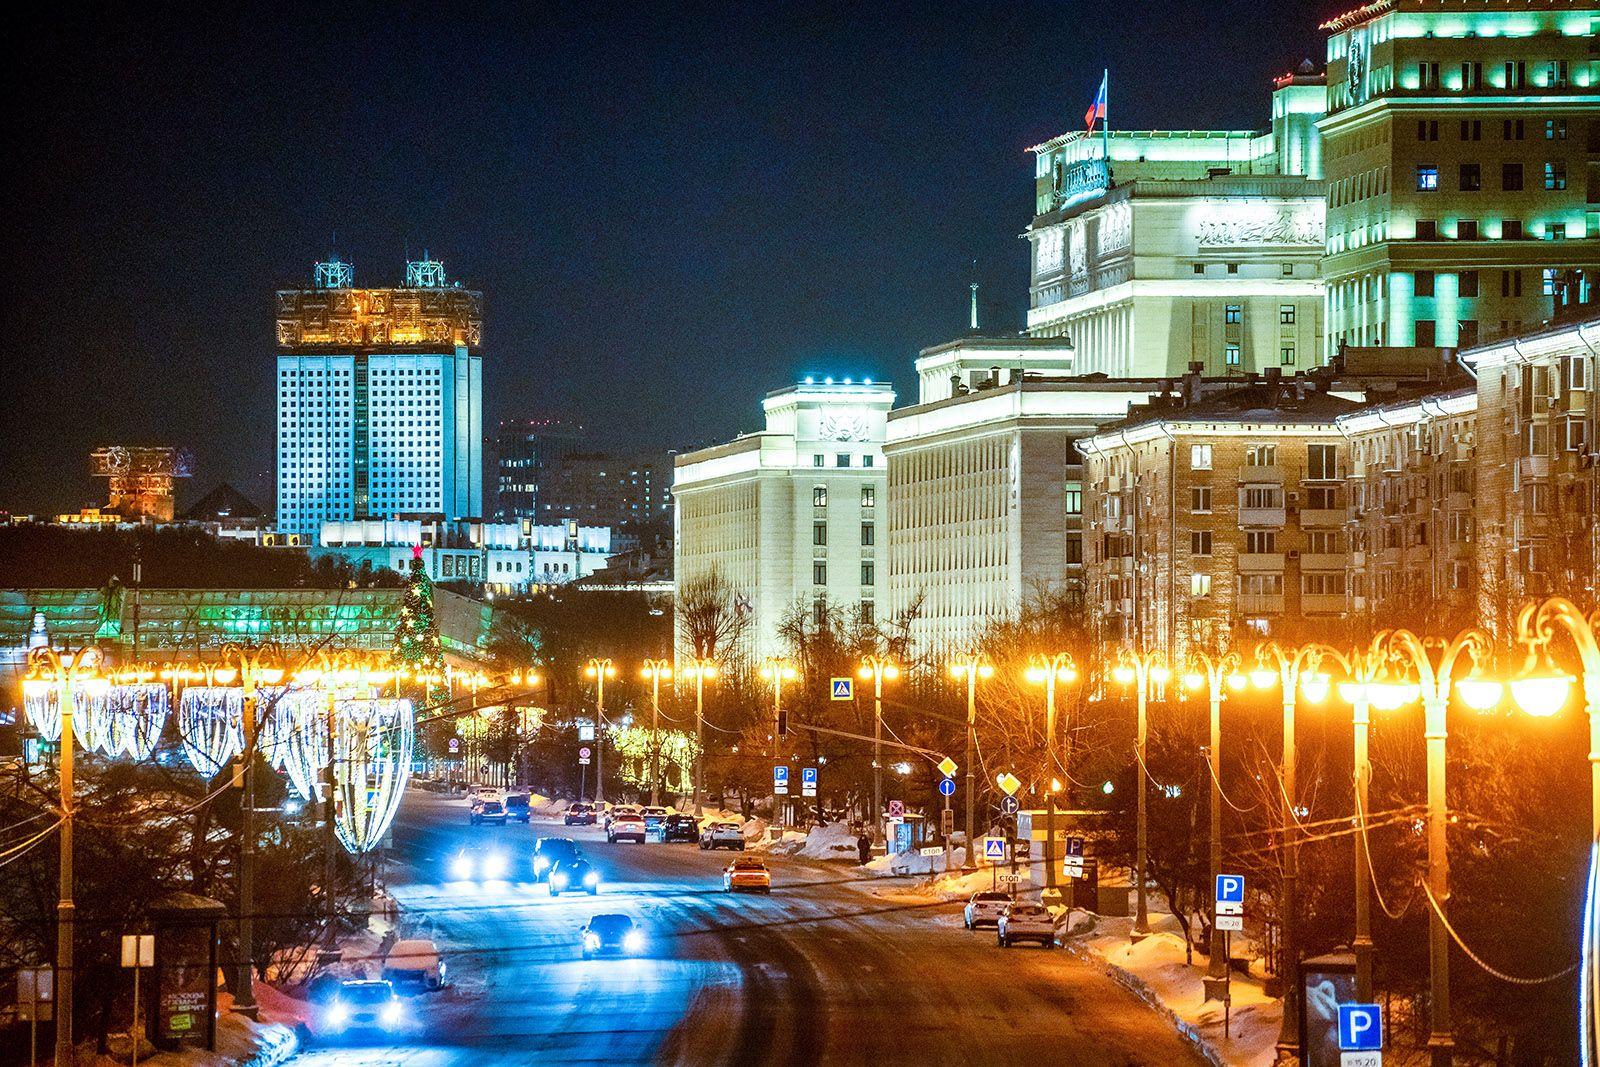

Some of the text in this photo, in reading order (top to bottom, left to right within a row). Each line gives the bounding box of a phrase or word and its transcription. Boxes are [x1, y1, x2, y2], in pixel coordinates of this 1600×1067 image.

[777, 768, 785, 779] P
[806, 770, 814, 781] P
[1071, 839, 1080, 854] P
[1223, 878, 1238, 899] P
[1350, 1010, 1372, 1044] P
